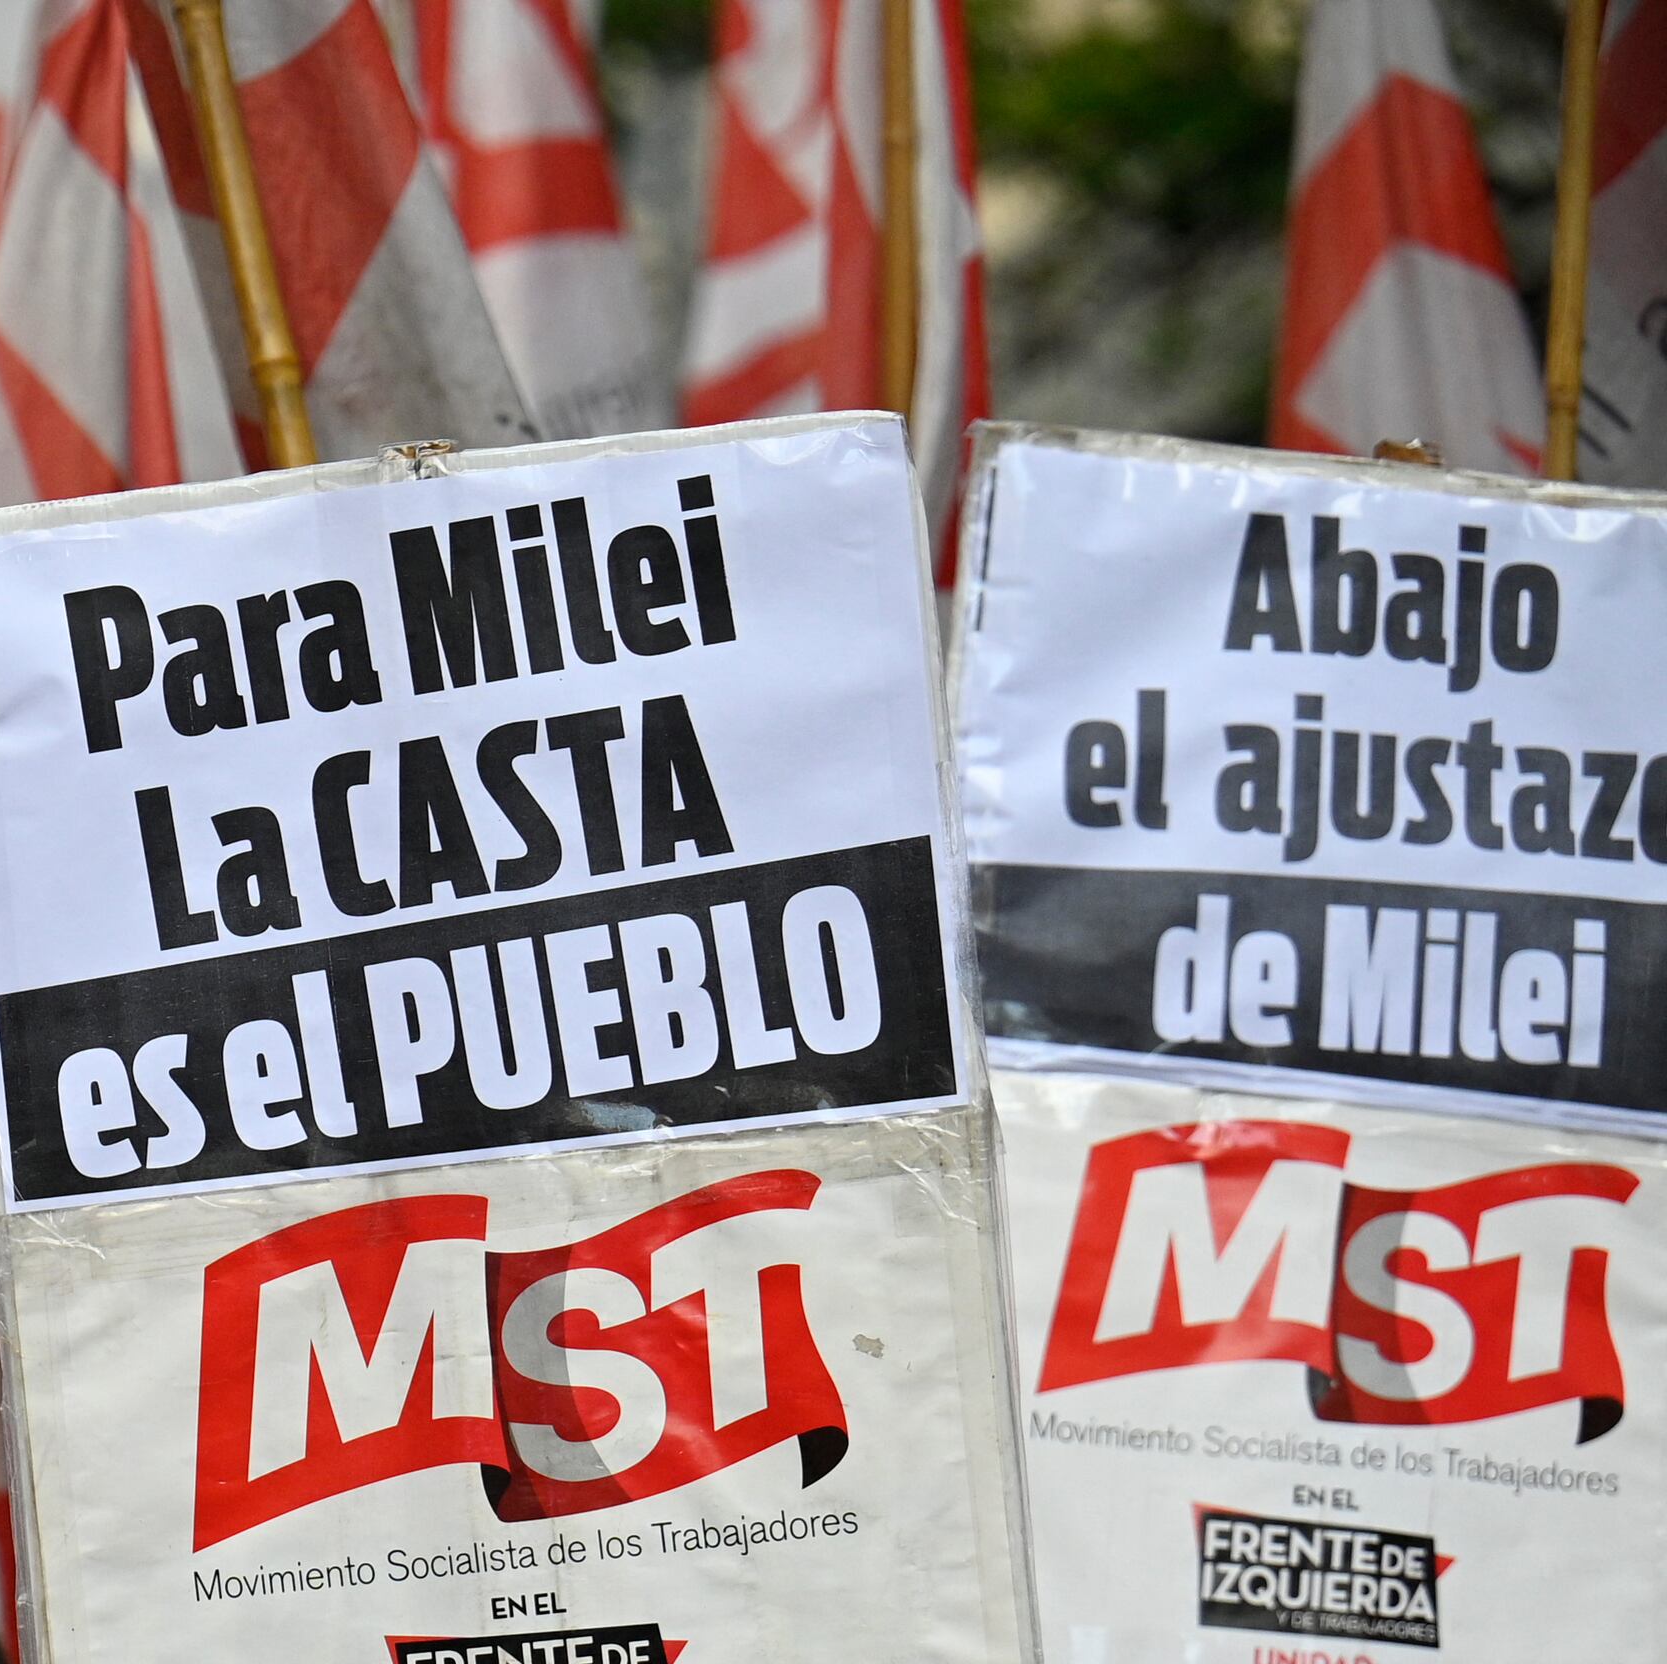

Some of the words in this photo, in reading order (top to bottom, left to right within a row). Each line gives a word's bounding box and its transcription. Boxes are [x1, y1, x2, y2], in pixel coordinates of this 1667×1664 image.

[63, 579, 381, 754] Para
[388, 474, 737, 696] Milei
[1223, 513, 1560, 692] Abajo
[134, 785, 301, 952] La
[312, 694, 733, 917] CASTA
[1063, 688, 1168, 829] el
[57, 1032, 205, 1178] es
[224, 969, 358, 1152] el
[363, 884, 882, 1129] PUEBLO
[1152, 895, 1298, 1049] de
[1318, 904, 1607, 1068] Milei
[248, 1208, 812, 1483] MST
[1093, 1160, 1631, 1400] MST
[1029, 1411, 1193, 1454] Movimiento
[1202, 1425, 1343, 1467] Socialista
[1350, 1442, 1386, 1471] de
[1395, 1446, 1433, 1475] los
[1443, 1448, 1619, 1496] Trabajadores
[1293, 1484, 1324, 1506] EN
[1332, 1489, 1359, 1511] EL
[194, 1557, 376, 1602] Movimiento
[387, 1540, 536, 1582] Socialista
[548, 1535, 587, 1566] de
[599, 1527, 643, 1561] los
[651, 1507, 859, 1555] Trabajadores
[491, 1597, 529, 1620] EN
[534, 1593, 566, 1615] EL
[1201, 1562, 1434, 1621] IZQUIERDA
[1204, 1520, 1380, 1574] FRENTE
[1381, 1544, 1426, 1579] DE
[1320, 1613, 1435, 1642] TRABAJADORES
